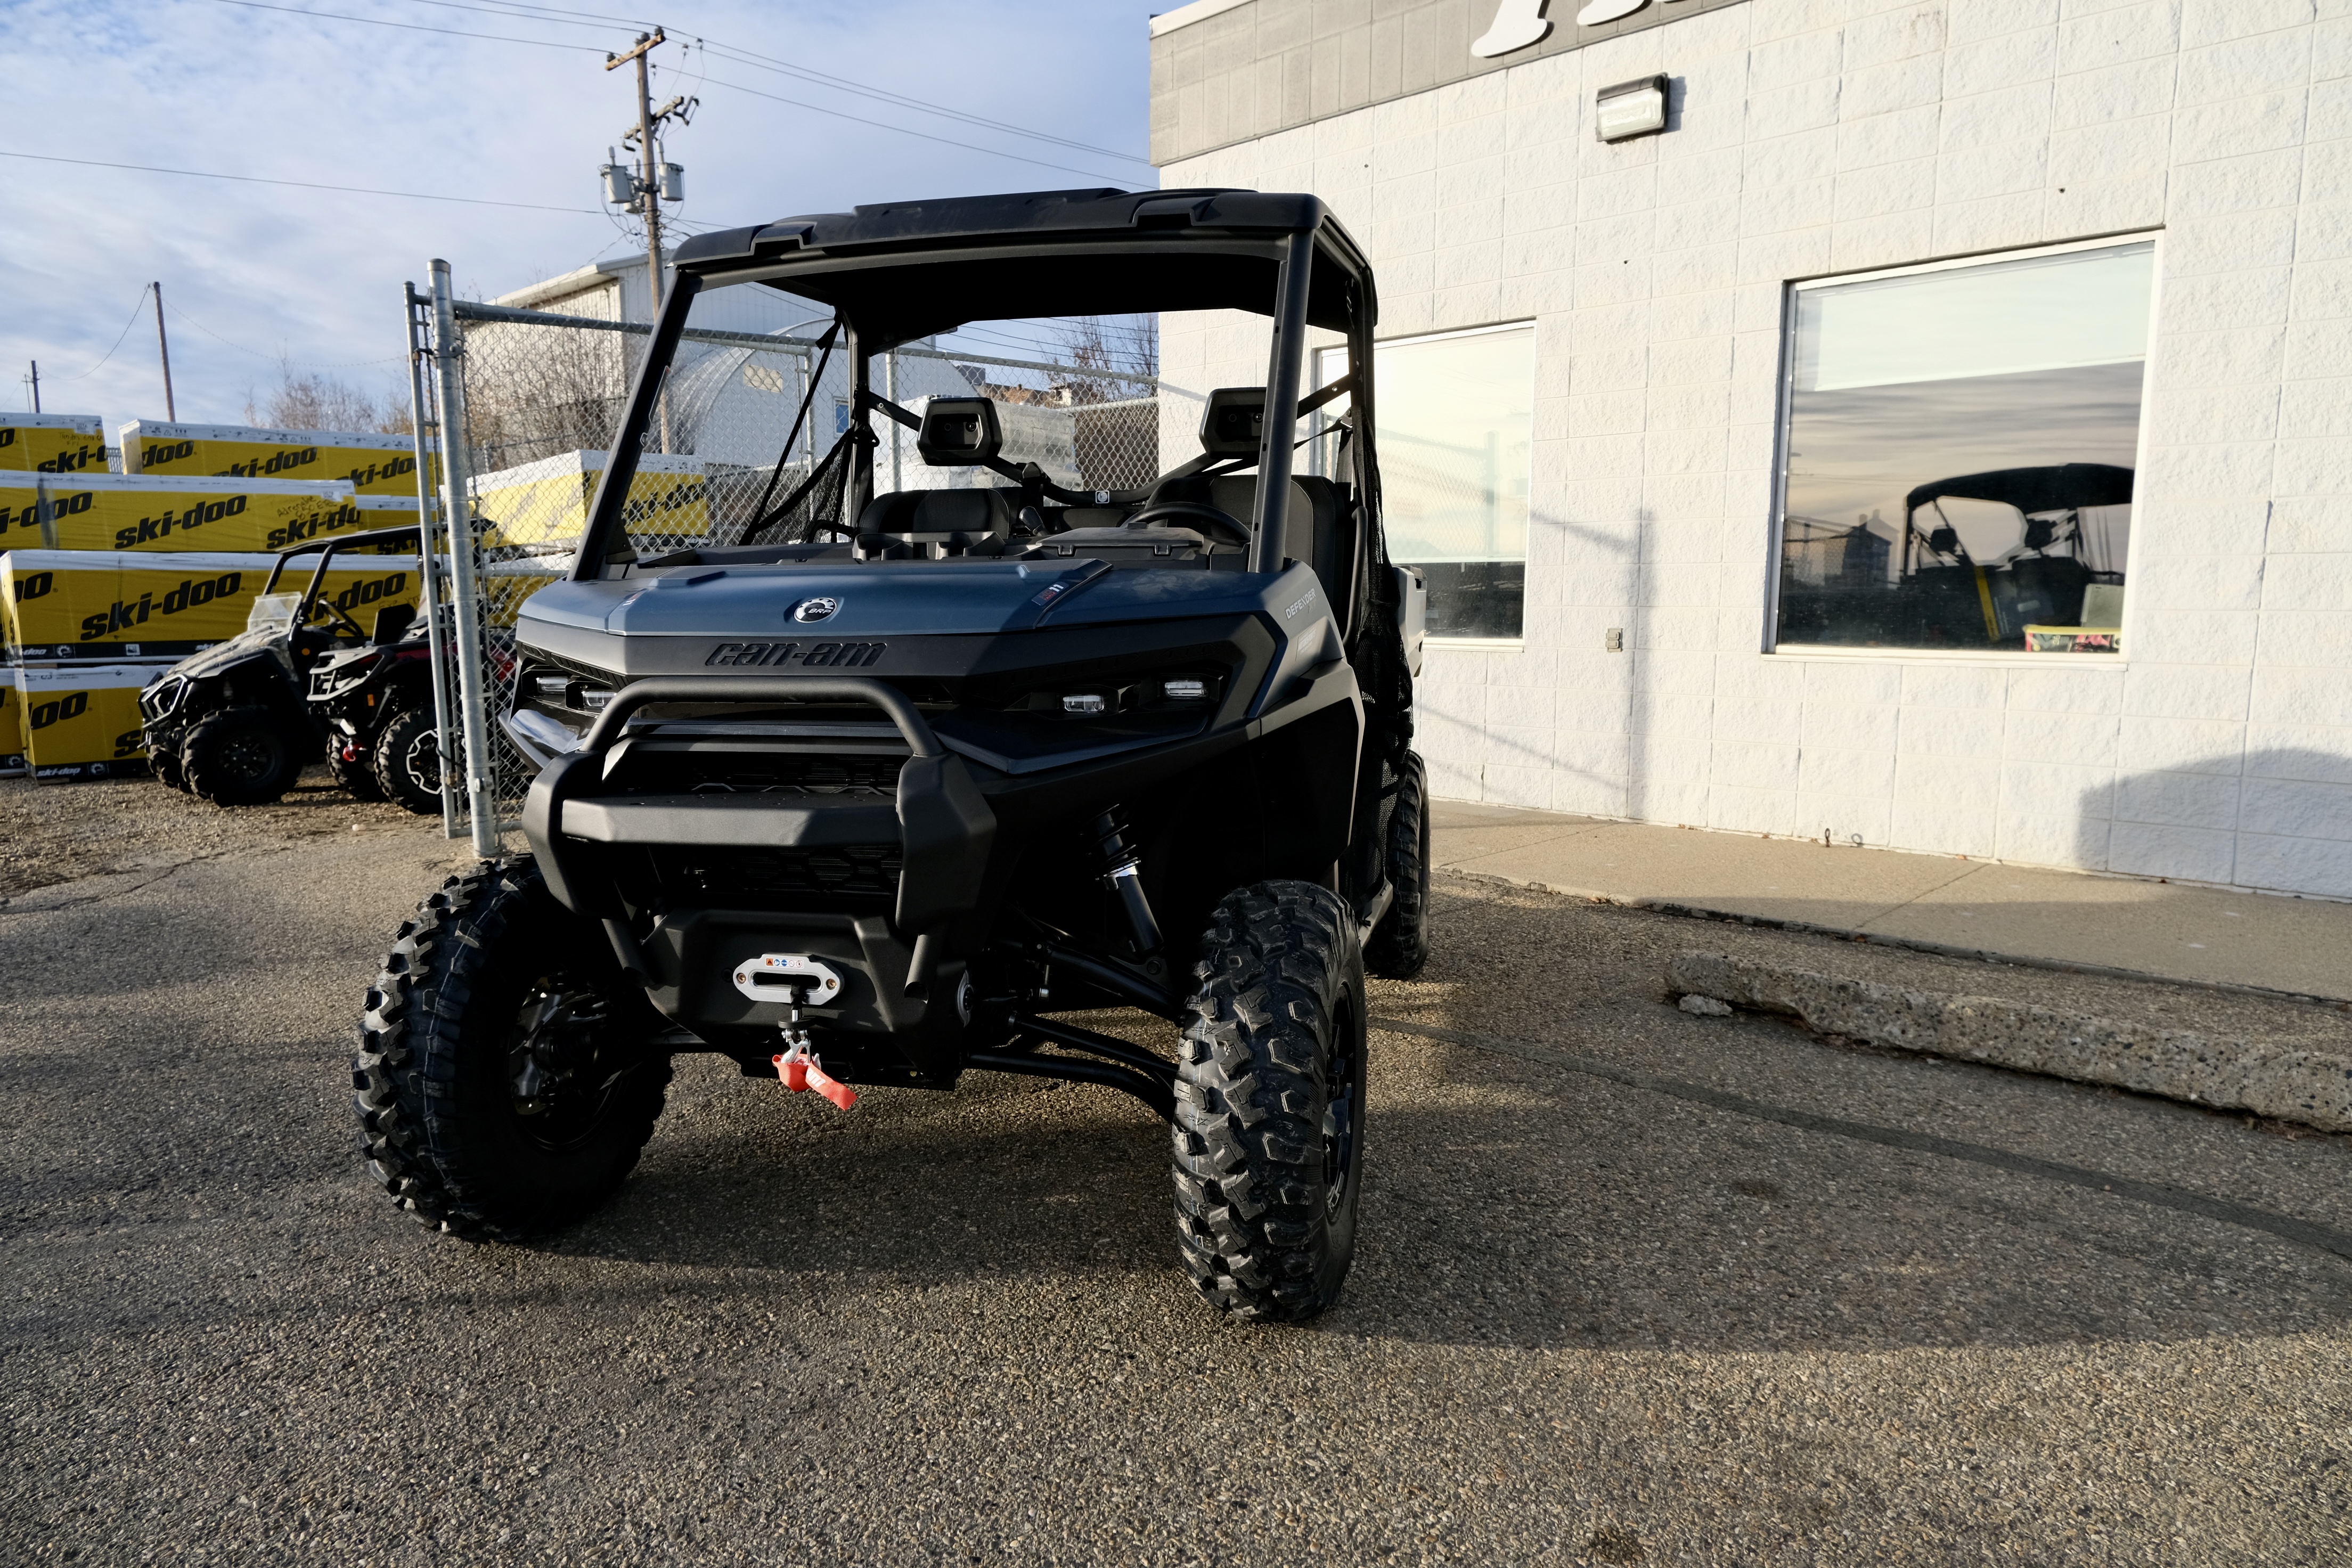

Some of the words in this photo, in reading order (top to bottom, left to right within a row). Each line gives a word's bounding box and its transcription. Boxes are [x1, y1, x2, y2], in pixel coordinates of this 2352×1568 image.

[334, 456, 429, 487] ki-do
[0, 492, 93, 533] i-doo
[115, 495, 247, 549] ski-doo
[80, 572, 241, 641] ski-doo
[1285, 588, 1316, 620] DEFENDER
[705, 642, 887, 667] can-am
[37, 767, 81, 777] ski-doo
